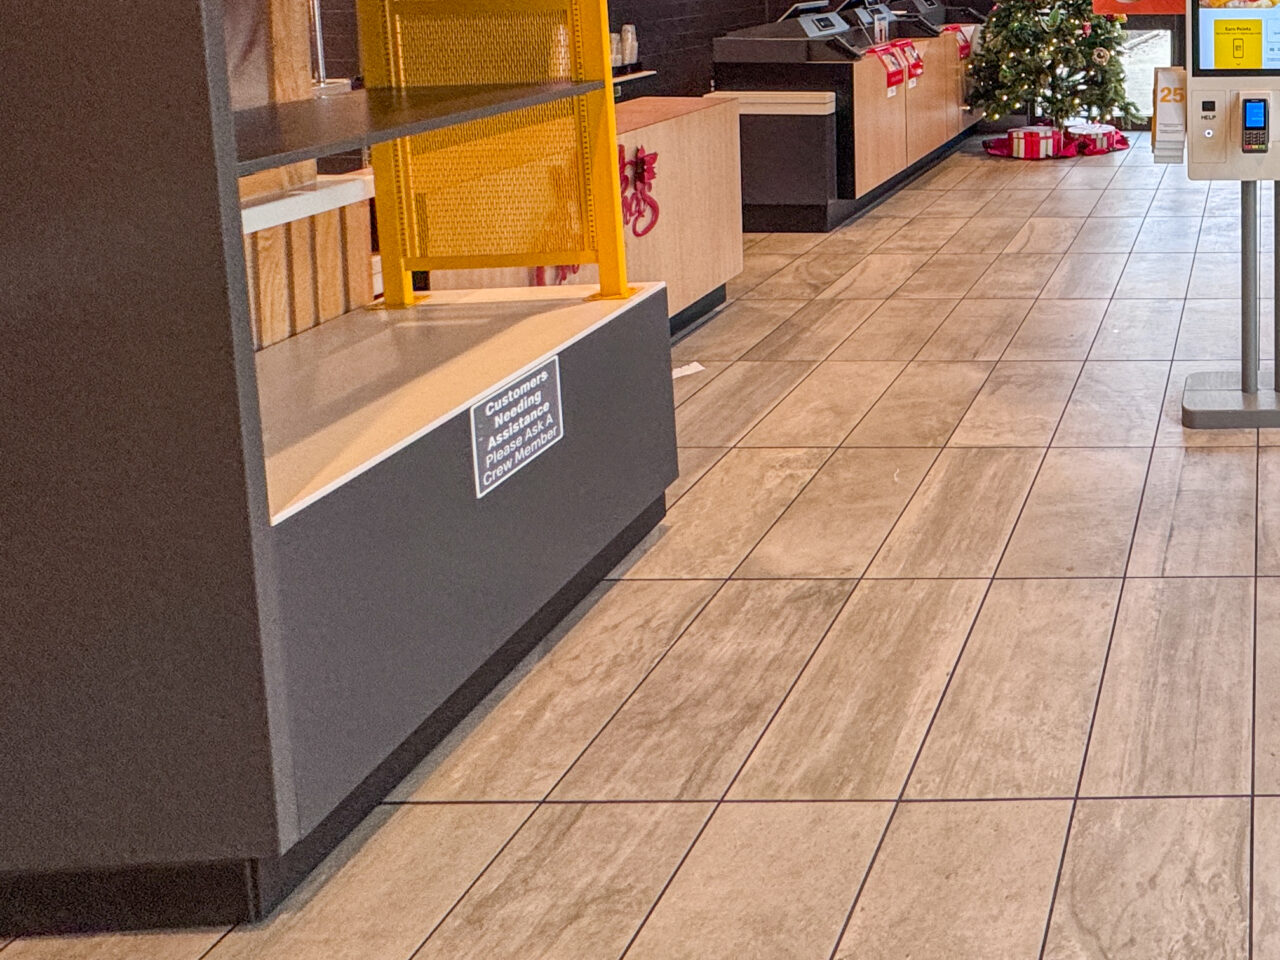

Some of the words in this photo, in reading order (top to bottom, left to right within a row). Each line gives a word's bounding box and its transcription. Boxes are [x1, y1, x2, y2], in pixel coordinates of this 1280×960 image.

[1160, 87, 1185, 103] 25
[485, 371, 549, 416] Customers
[494, 390, 542, 429] Needing
[486, 436, 523, 468] Please
[525, 421, 544, 441] Ask
[546, 413, 554, 427] A
[488, 402, 550, 451] Assistance
[483, 458, 513, 486] Crew
[515, 425, 558, 463] Member
